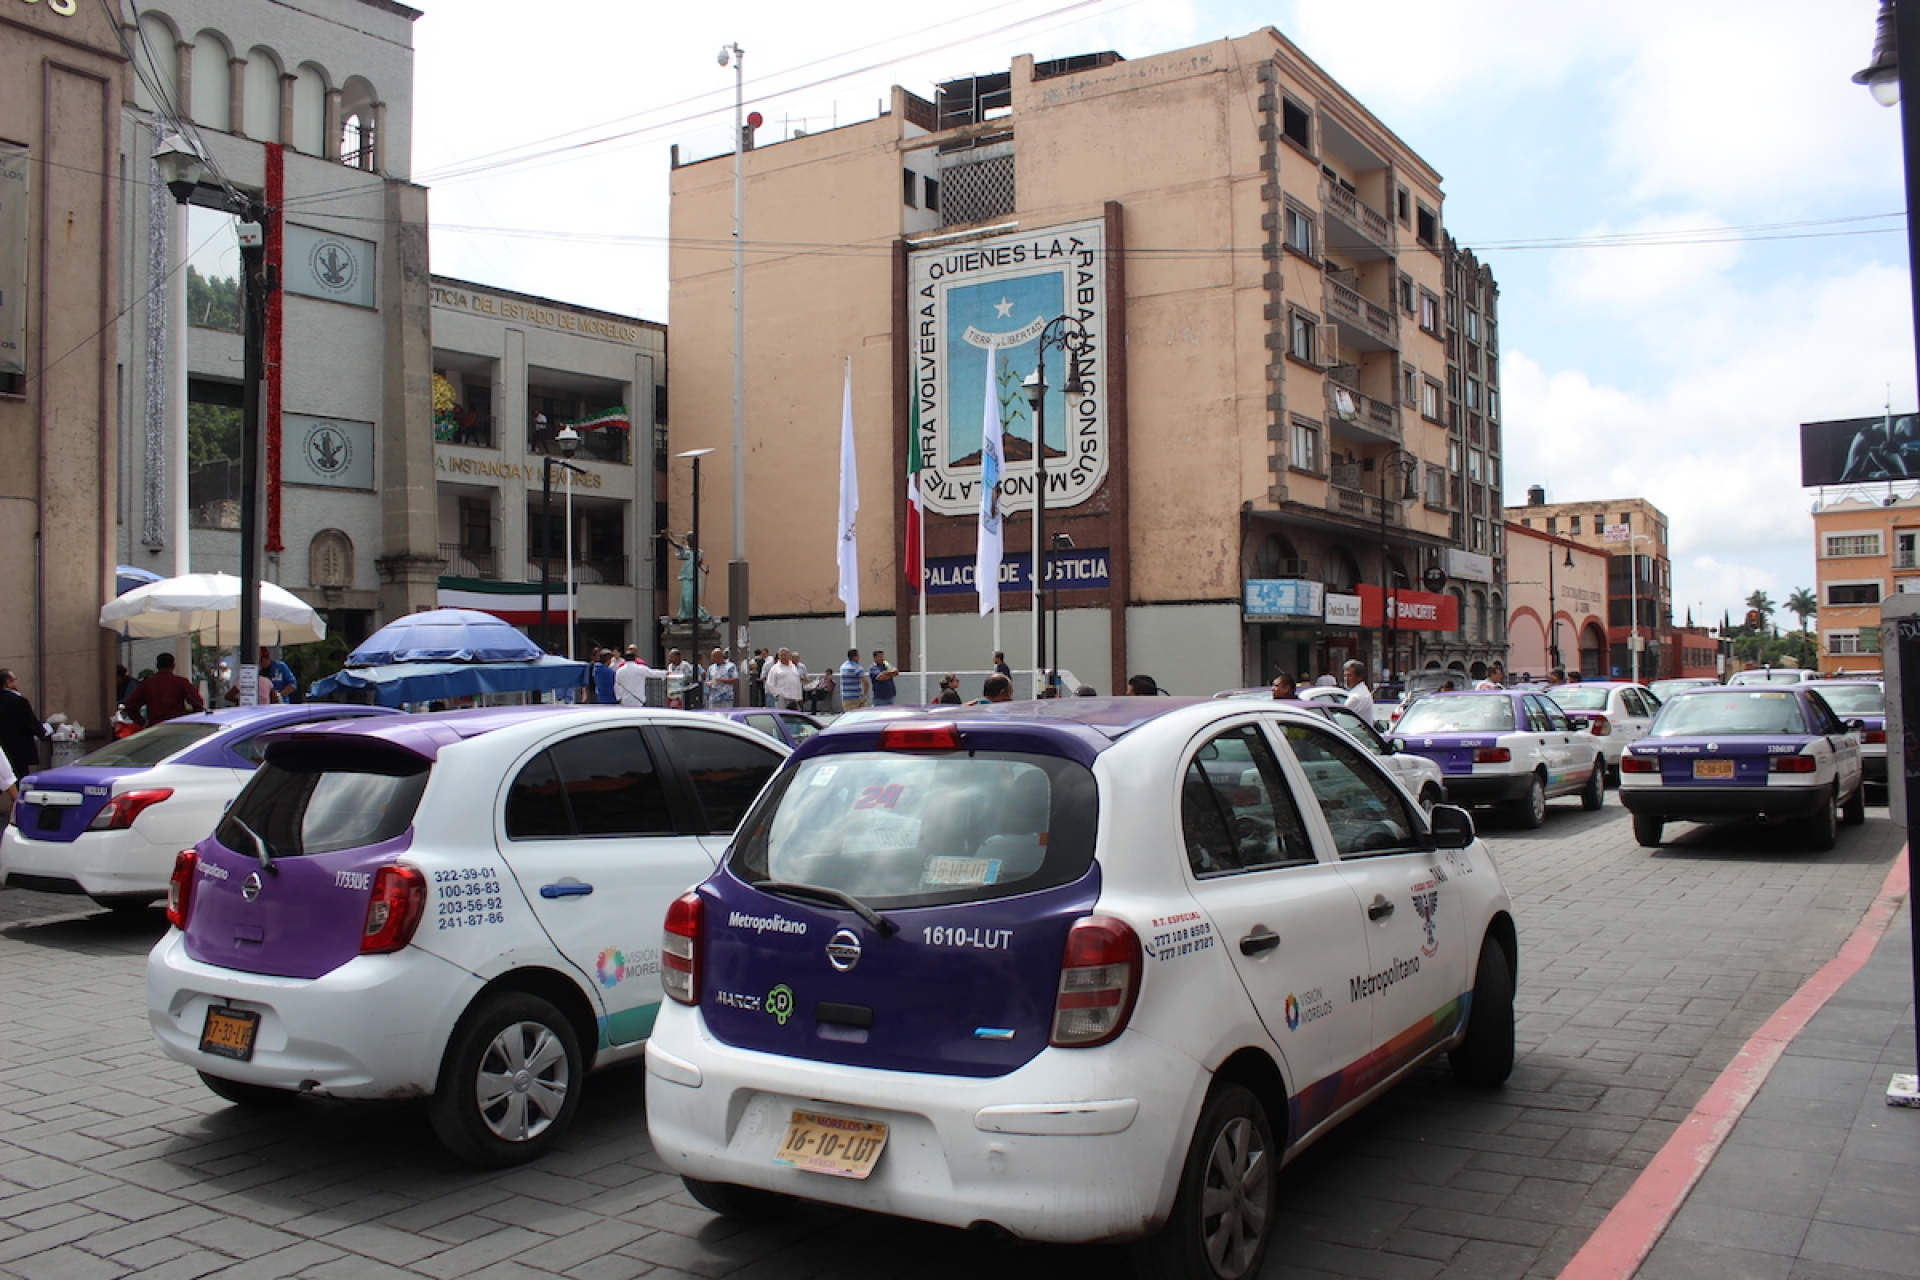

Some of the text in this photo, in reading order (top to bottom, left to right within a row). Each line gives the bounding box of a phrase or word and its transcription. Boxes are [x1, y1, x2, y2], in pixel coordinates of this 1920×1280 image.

[1034, 238, 1064, 260] LA
[929, 244, 1027, 280] QUIENES
[920, 283, 936, 299] A
[472, 295, 498, 313] DEL
[501, 300, 555, 326] ESTADO
[558, 313, 577, 330] DE
[578, 315, 638, 342] MORELOS
[969, 331, 993, 346] TIERR
[1001, 321, 1044, 346] LIBERTAD
[920, 302, 936, 414] VOLVERA
[1079, 379, 1097, 436] CON
[450, 456, 522, 480] INSTANCIA
[523, 466, 534, 481] Y
[922, 417, 957, 500] TIERRA
[1070, 438, 1097, 486] SUS
[924, 557, 1108, 586] PALACI DE USTICIA
[854, 783, 905, 810] 24
[335, 870, 371, 891] 1733LVE
[434, 866, 497, 883] 322-39-01
[438, 881, 501, 899] 100-36-83
[438, 896, 504, 916] 203-56-92
[1167, 911, 1201, 926] ESPECIAL
[438, 911, 505, 931] 241-87-86
[728, 911, 808, 935] Metropolitano
[922, 926, 1014, 951] 1610-LUT
[1154, 933, 1171, 949] 777
[1159, 946, 1176, 962] 777
[1194, 935, 1214, 952] 2727
[1350, 956, 1420, 1003] Metropolitano
[1300, 1000, 1334, 1024] MORELOS
[816, 1116, 862, 1132] MORELOS
[786, 1127, 882, 1164] 16-10-LUT
